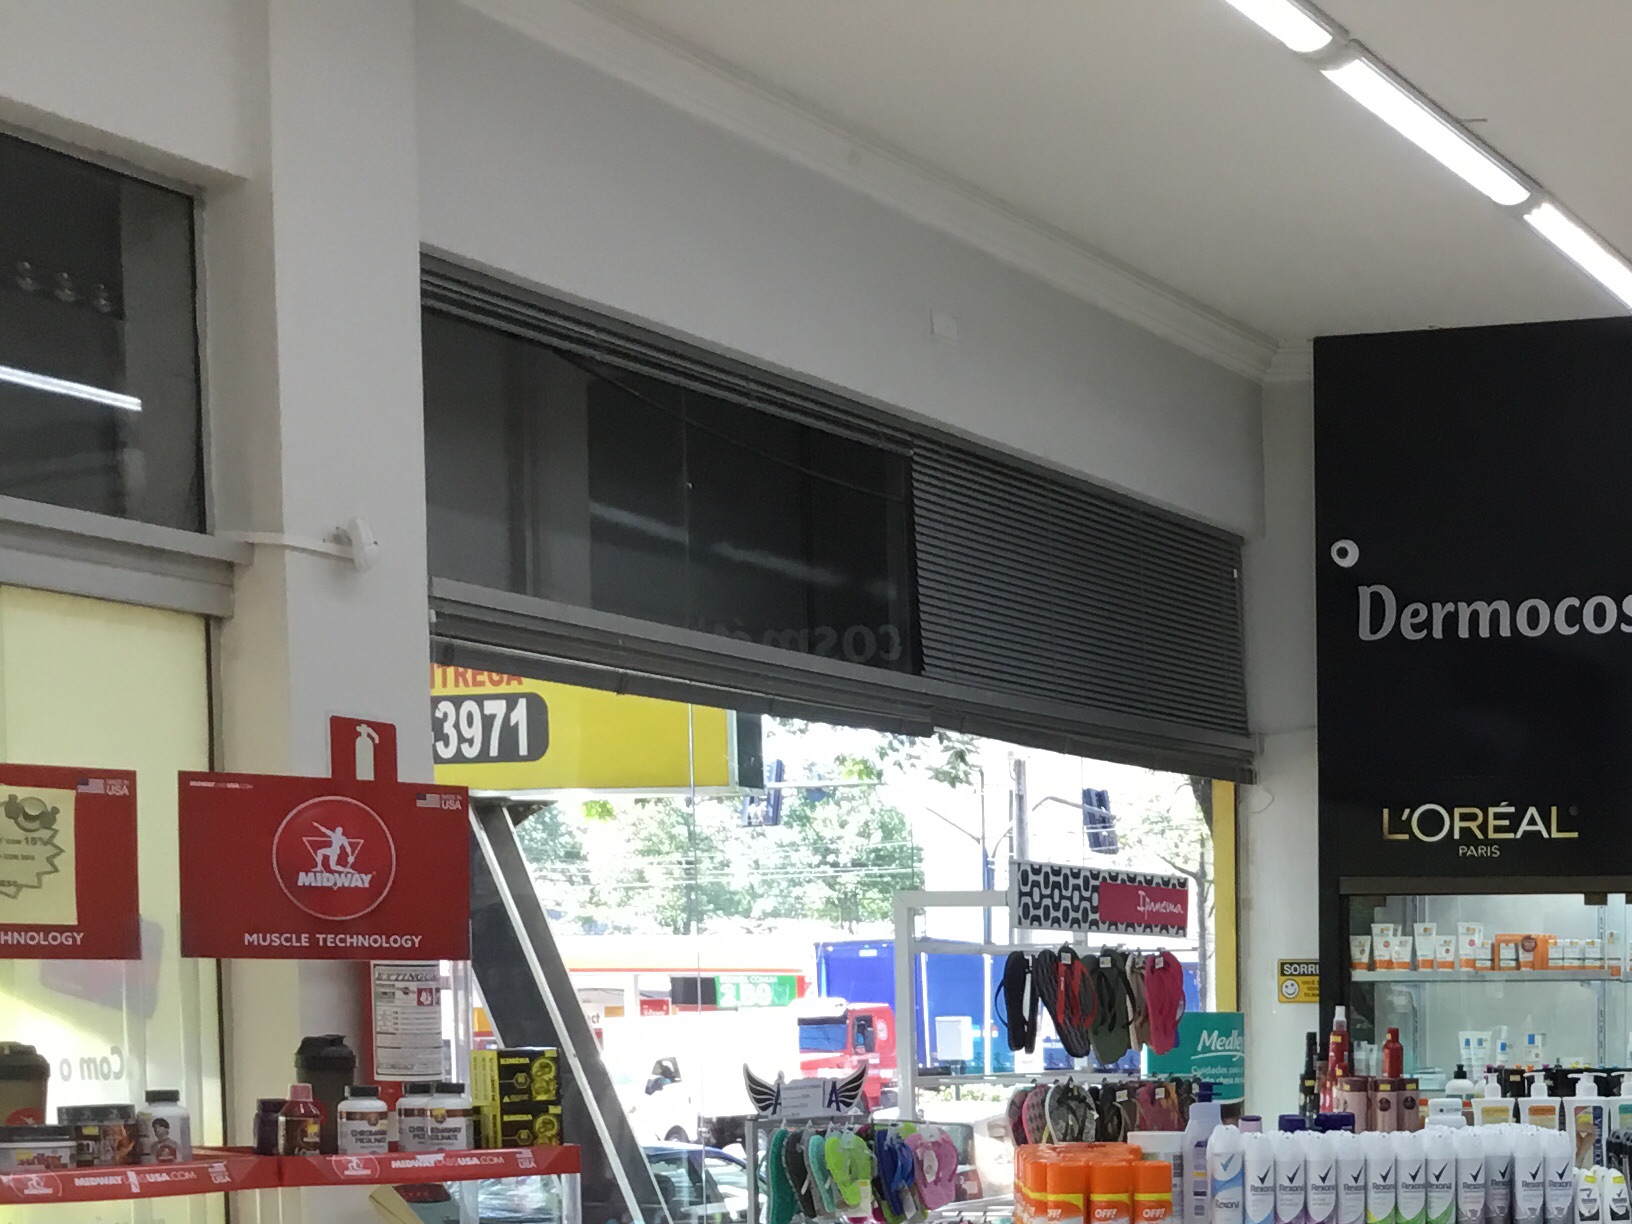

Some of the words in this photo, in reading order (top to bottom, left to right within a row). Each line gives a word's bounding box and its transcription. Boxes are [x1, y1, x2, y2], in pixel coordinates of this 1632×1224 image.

[106, 785, 130, 796] USA
[441, 800, 462, 810] USA
[1383, 800, 1578, 840] L'ORÉAL
[1458, 844, 1501, 858] PARIS
[298, 871, 372, 889] MIDWAY
[244, 933, 309, 947] MUSCLE
[316, 933, 422, 948] TECHNOLOGY
